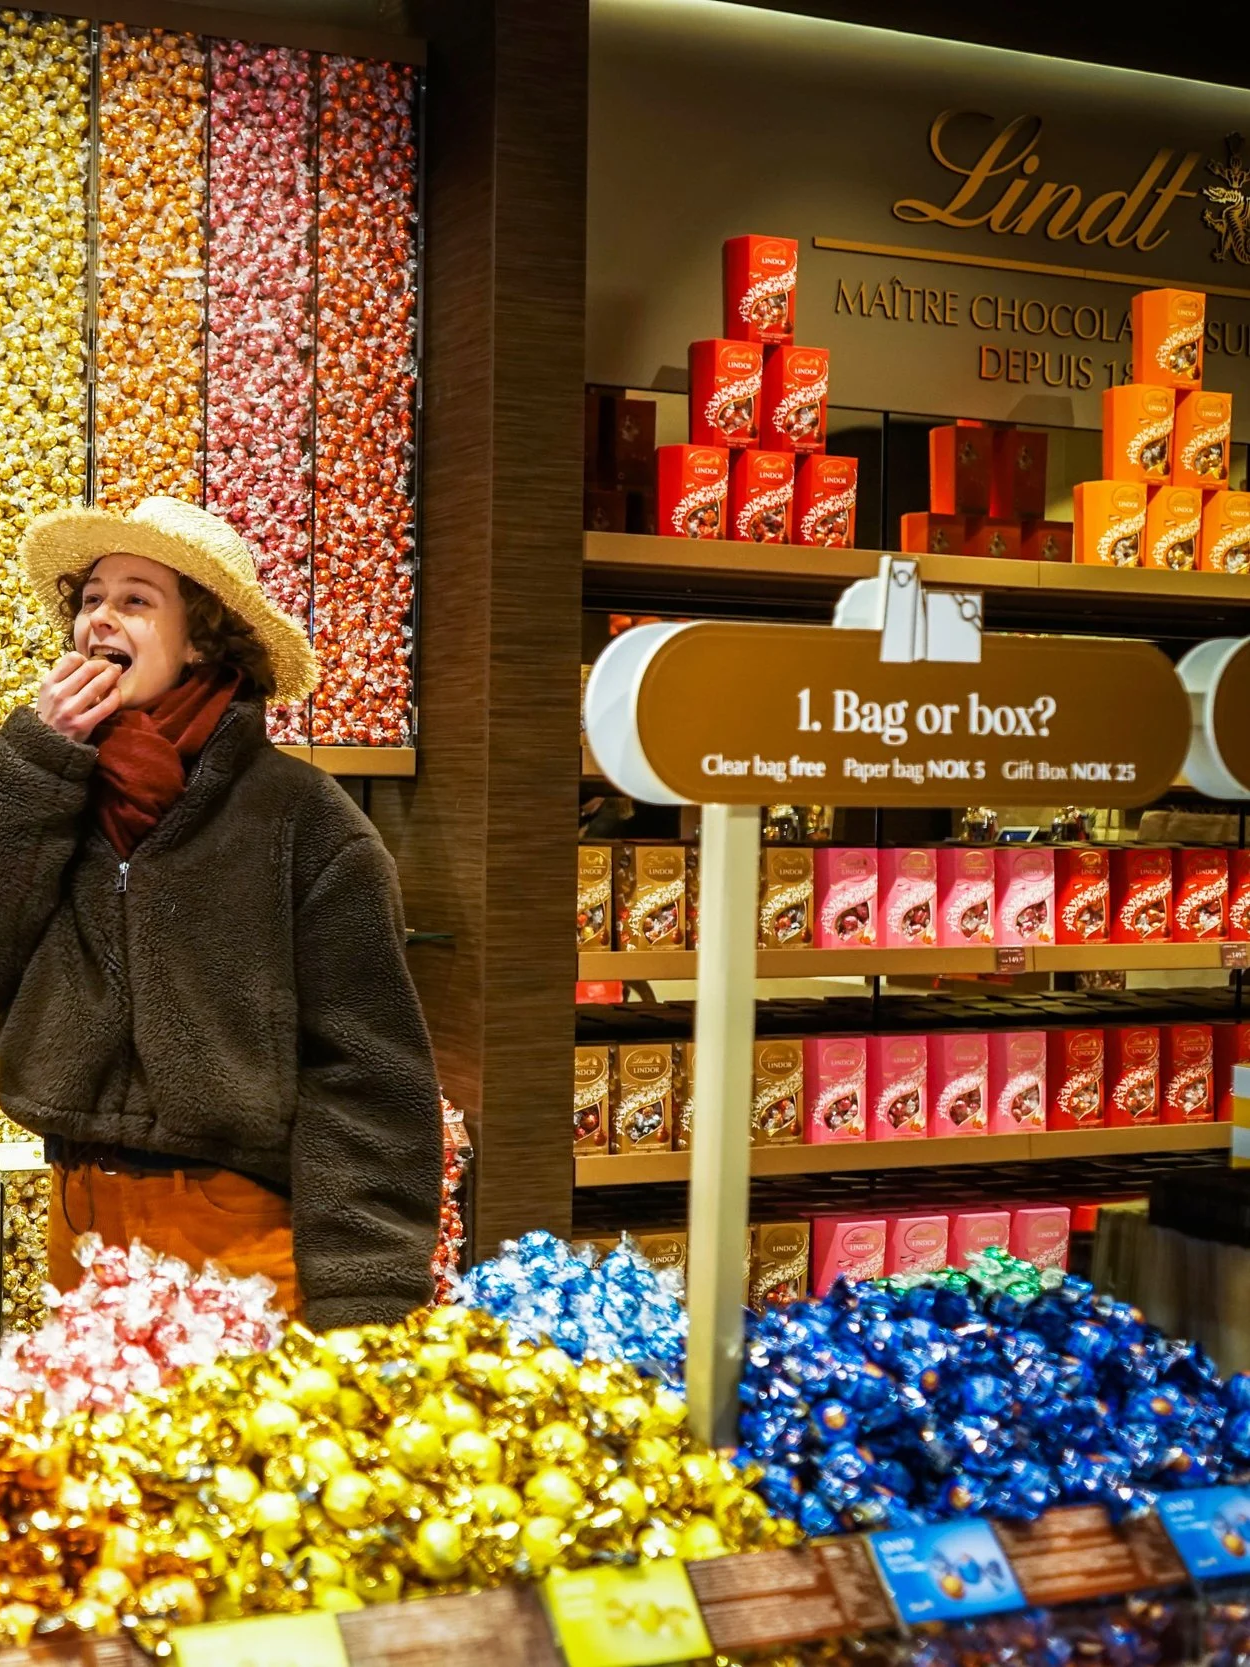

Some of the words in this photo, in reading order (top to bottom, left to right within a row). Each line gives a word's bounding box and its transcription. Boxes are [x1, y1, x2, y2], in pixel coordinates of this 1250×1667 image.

[892, 110, 1202, 252] Lindt
[761, 257, 786, 266] LINDOR
[835, 276, 959, 328] MAÎTRE
[971, 293, 1134, 342] CHOCOLA
[727, 361, 752, 370] LINDOR
[979, 344, 1093, 389] DEPUIS
[794, 367, 818, 376] LINDOR
[694, 467, 719, 475] LINDOR
[759, 471, 784, 480] LINDOR
[823, 476, 847, 484] LINDOR
[797, 687, 822, 732] 1.
[832, 689, 909, 746] Bag
[915, 703, 960, 735] or
[968, 692, 1057, 738] box?
[701, 753, 750, 776] Clear
[753, 754, 787, 783] bag
[789, 754, 827, 777] free
[842, 757, 890, 784] Paper
[892, 758, 925, 785] bag
[926, 759, 970, 780] NOK
[973, 760, 986, 780] 5
[1001, 759, 1034, 780] Gift
[1037, 761, 1068, 781] Box
[1070, 761, 1112, 781] NOK
[1114, 763, 1136, 781] 25
[767, 1061, 793, 1069] LINDOR
[575, 1068, 597, 1076] NDOR
[772, 1244, 798, 1253] LINDOR
[850, 1243, 875, 1251] LINDOR
[652, 1255, 676, 1264] LINDOR
